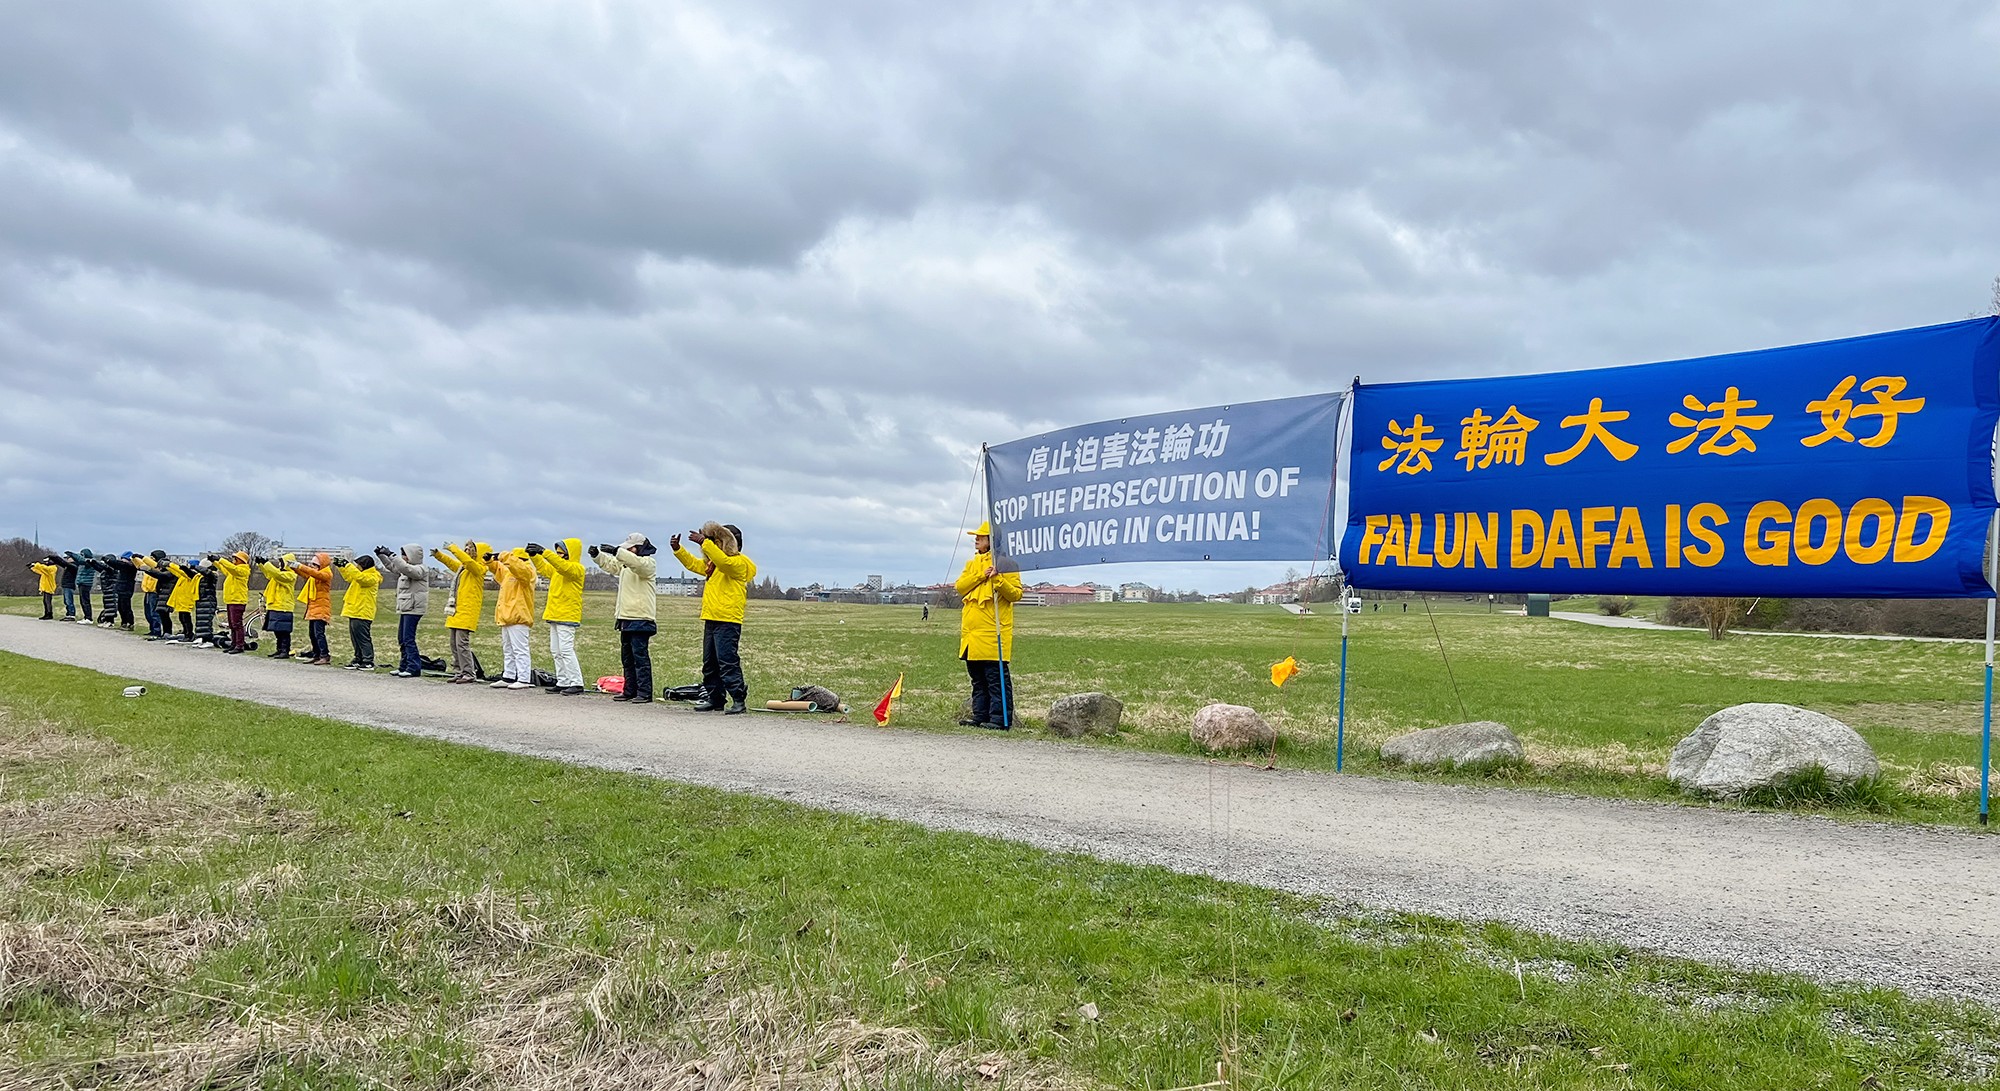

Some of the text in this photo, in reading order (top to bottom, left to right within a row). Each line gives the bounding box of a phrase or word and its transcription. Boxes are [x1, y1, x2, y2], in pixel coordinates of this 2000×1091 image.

[1026, 419, 1230, 481] 停止迫害法輪功
[1379, 375, 1926, 475] 法輪大法好
[994, 468, 1300, 525] STOP THE PERSECUTION OF
[1007, 511, 1261, 557] FALUN GONG IN CHINA!
[1358, 496, 1952, 570] FALUN DAFA IS GOOD
